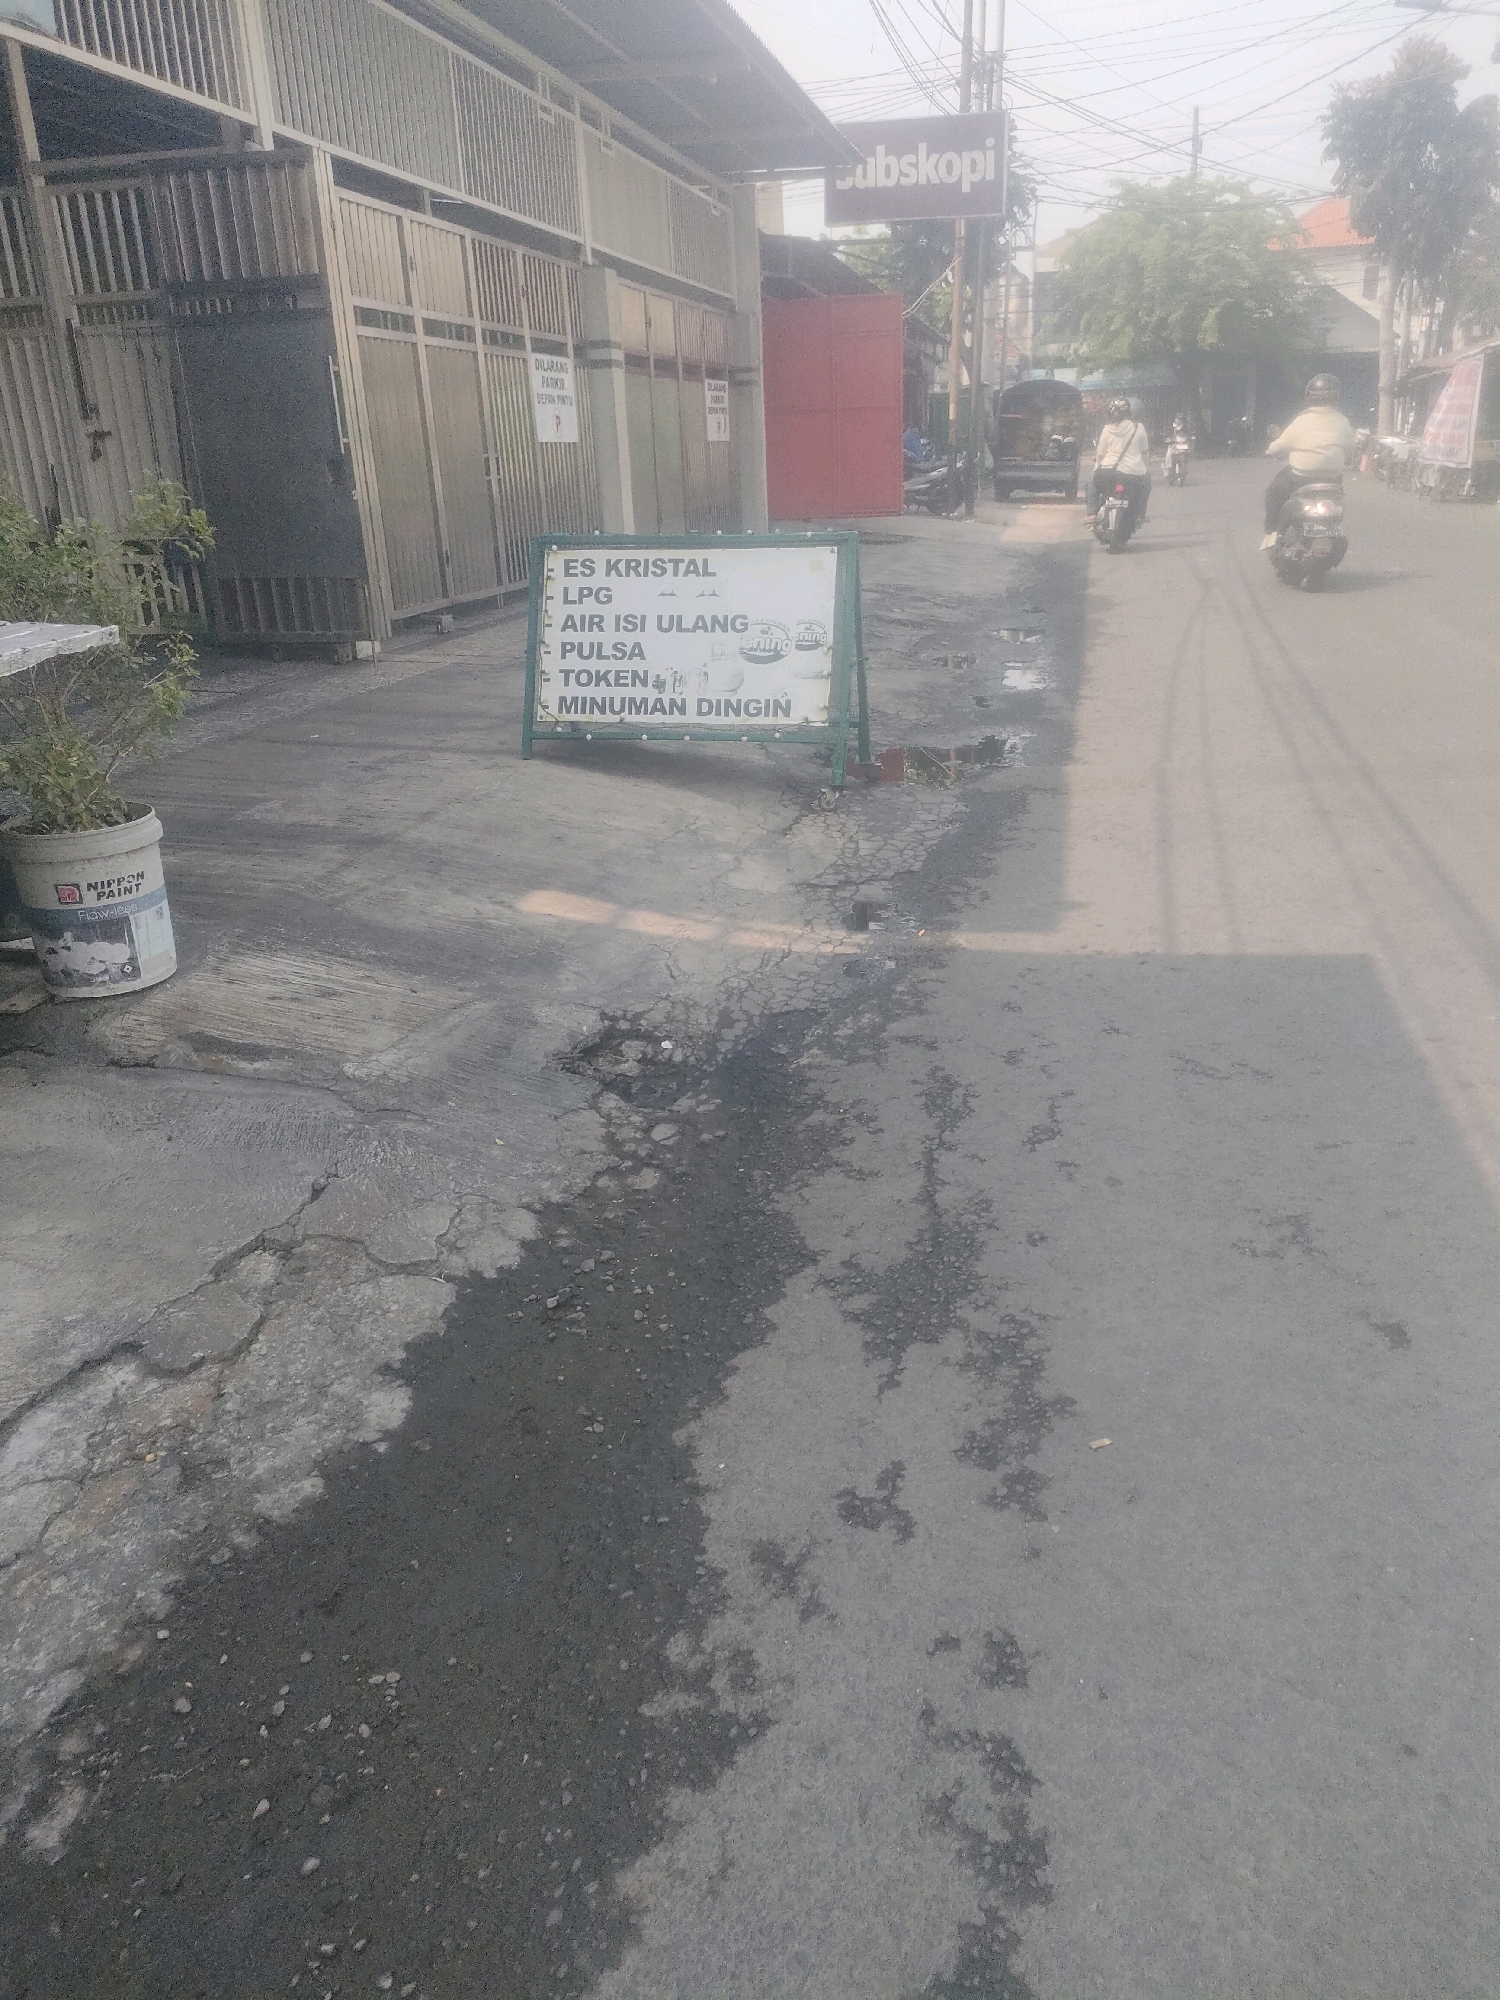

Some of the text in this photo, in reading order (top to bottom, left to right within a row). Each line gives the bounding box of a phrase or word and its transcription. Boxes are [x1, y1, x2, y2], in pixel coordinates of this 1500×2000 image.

[535, 359, 569, 374] DILARANG
[541, 376, 566, 390] PARKIR
[536, 393, 573, 406] DEPAN PINTU
[563, 558, 717, 578] ES KRISTAL
[562, 586, 613, 605] LPG
[560, 614, 749, 634] AIR ISI ULANG
[560, 641, 646, 661] PULSA
[741, 635, 792, 657] ening
[559, 668, 649, 688] TOKEN
[557, 696, 792, 718] MINUMAN DINGIN
[86, 870, 145, 892] NIPPON
[96, 883, 142, 901] PAINT
[77, 903, 138, 922] Flaw-less
